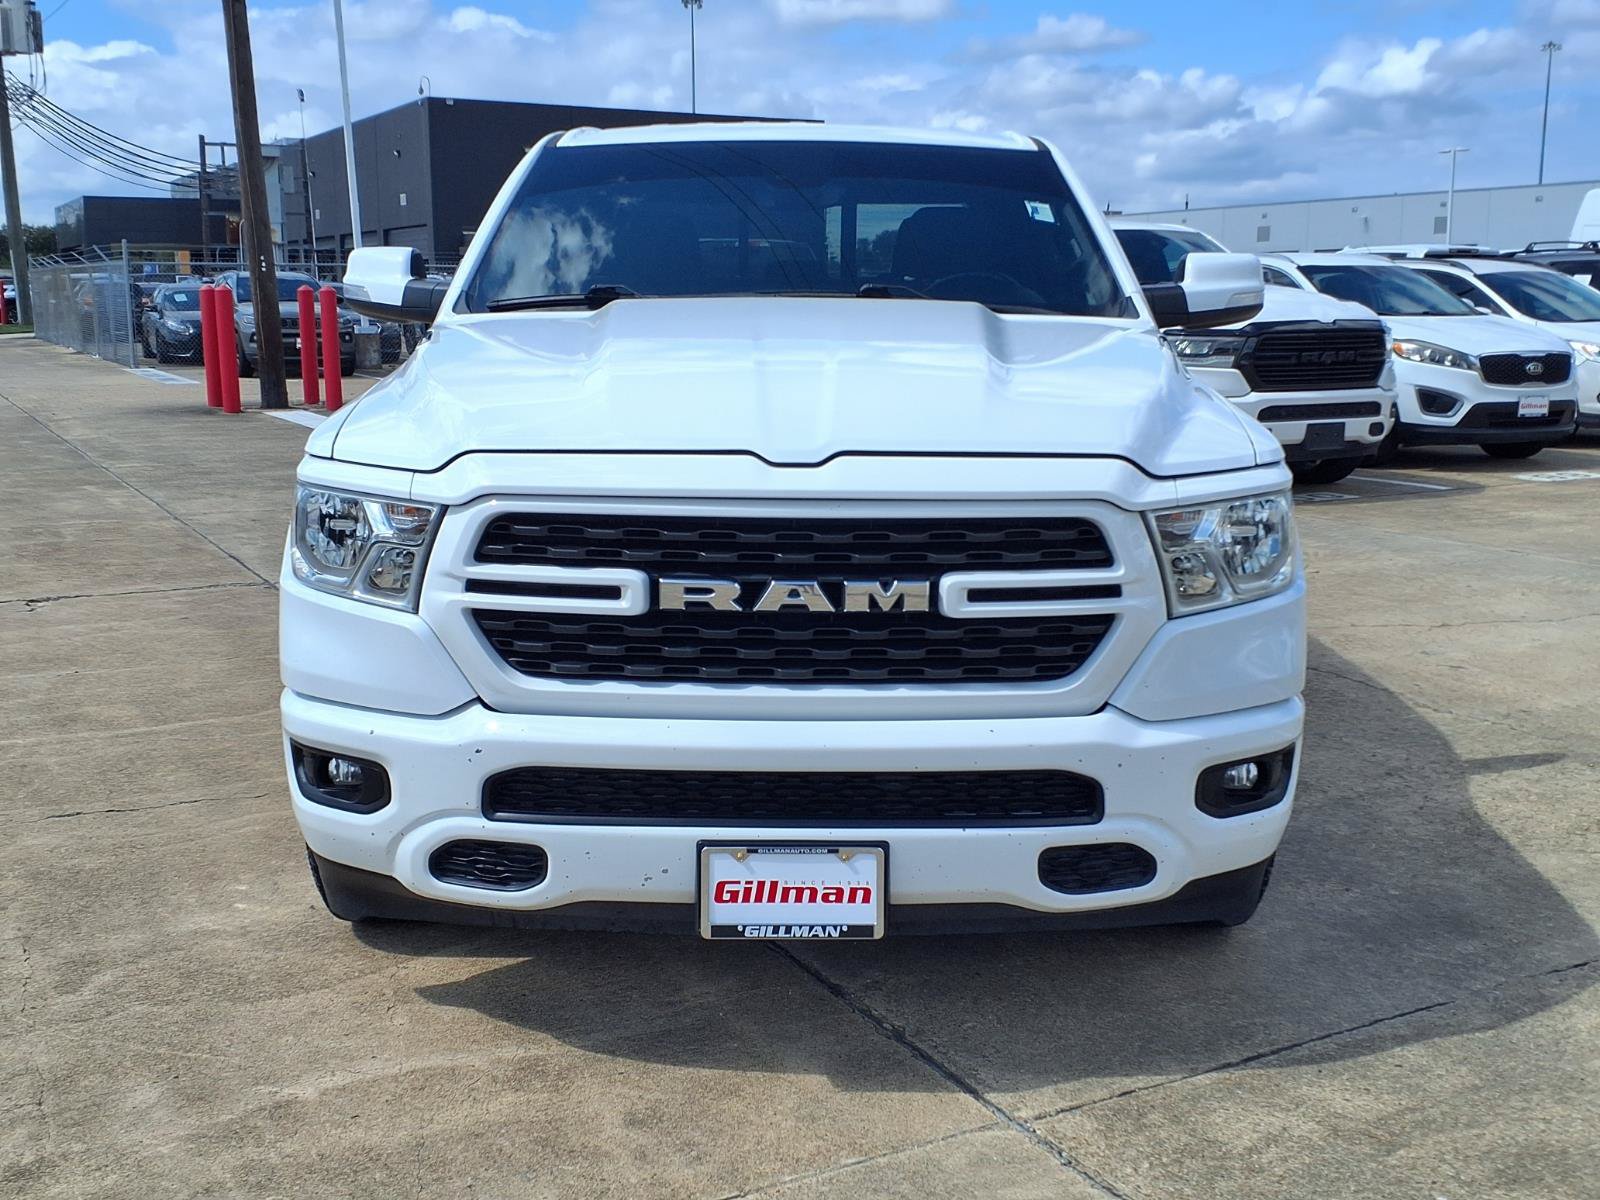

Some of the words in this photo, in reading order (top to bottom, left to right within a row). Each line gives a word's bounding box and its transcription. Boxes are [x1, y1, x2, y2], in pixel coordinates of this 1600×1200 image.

[658, 577, 930, 612] RAM
[714, 880, 872, 904] Gillman
[744, 925, 840, 937] GILLMAN
